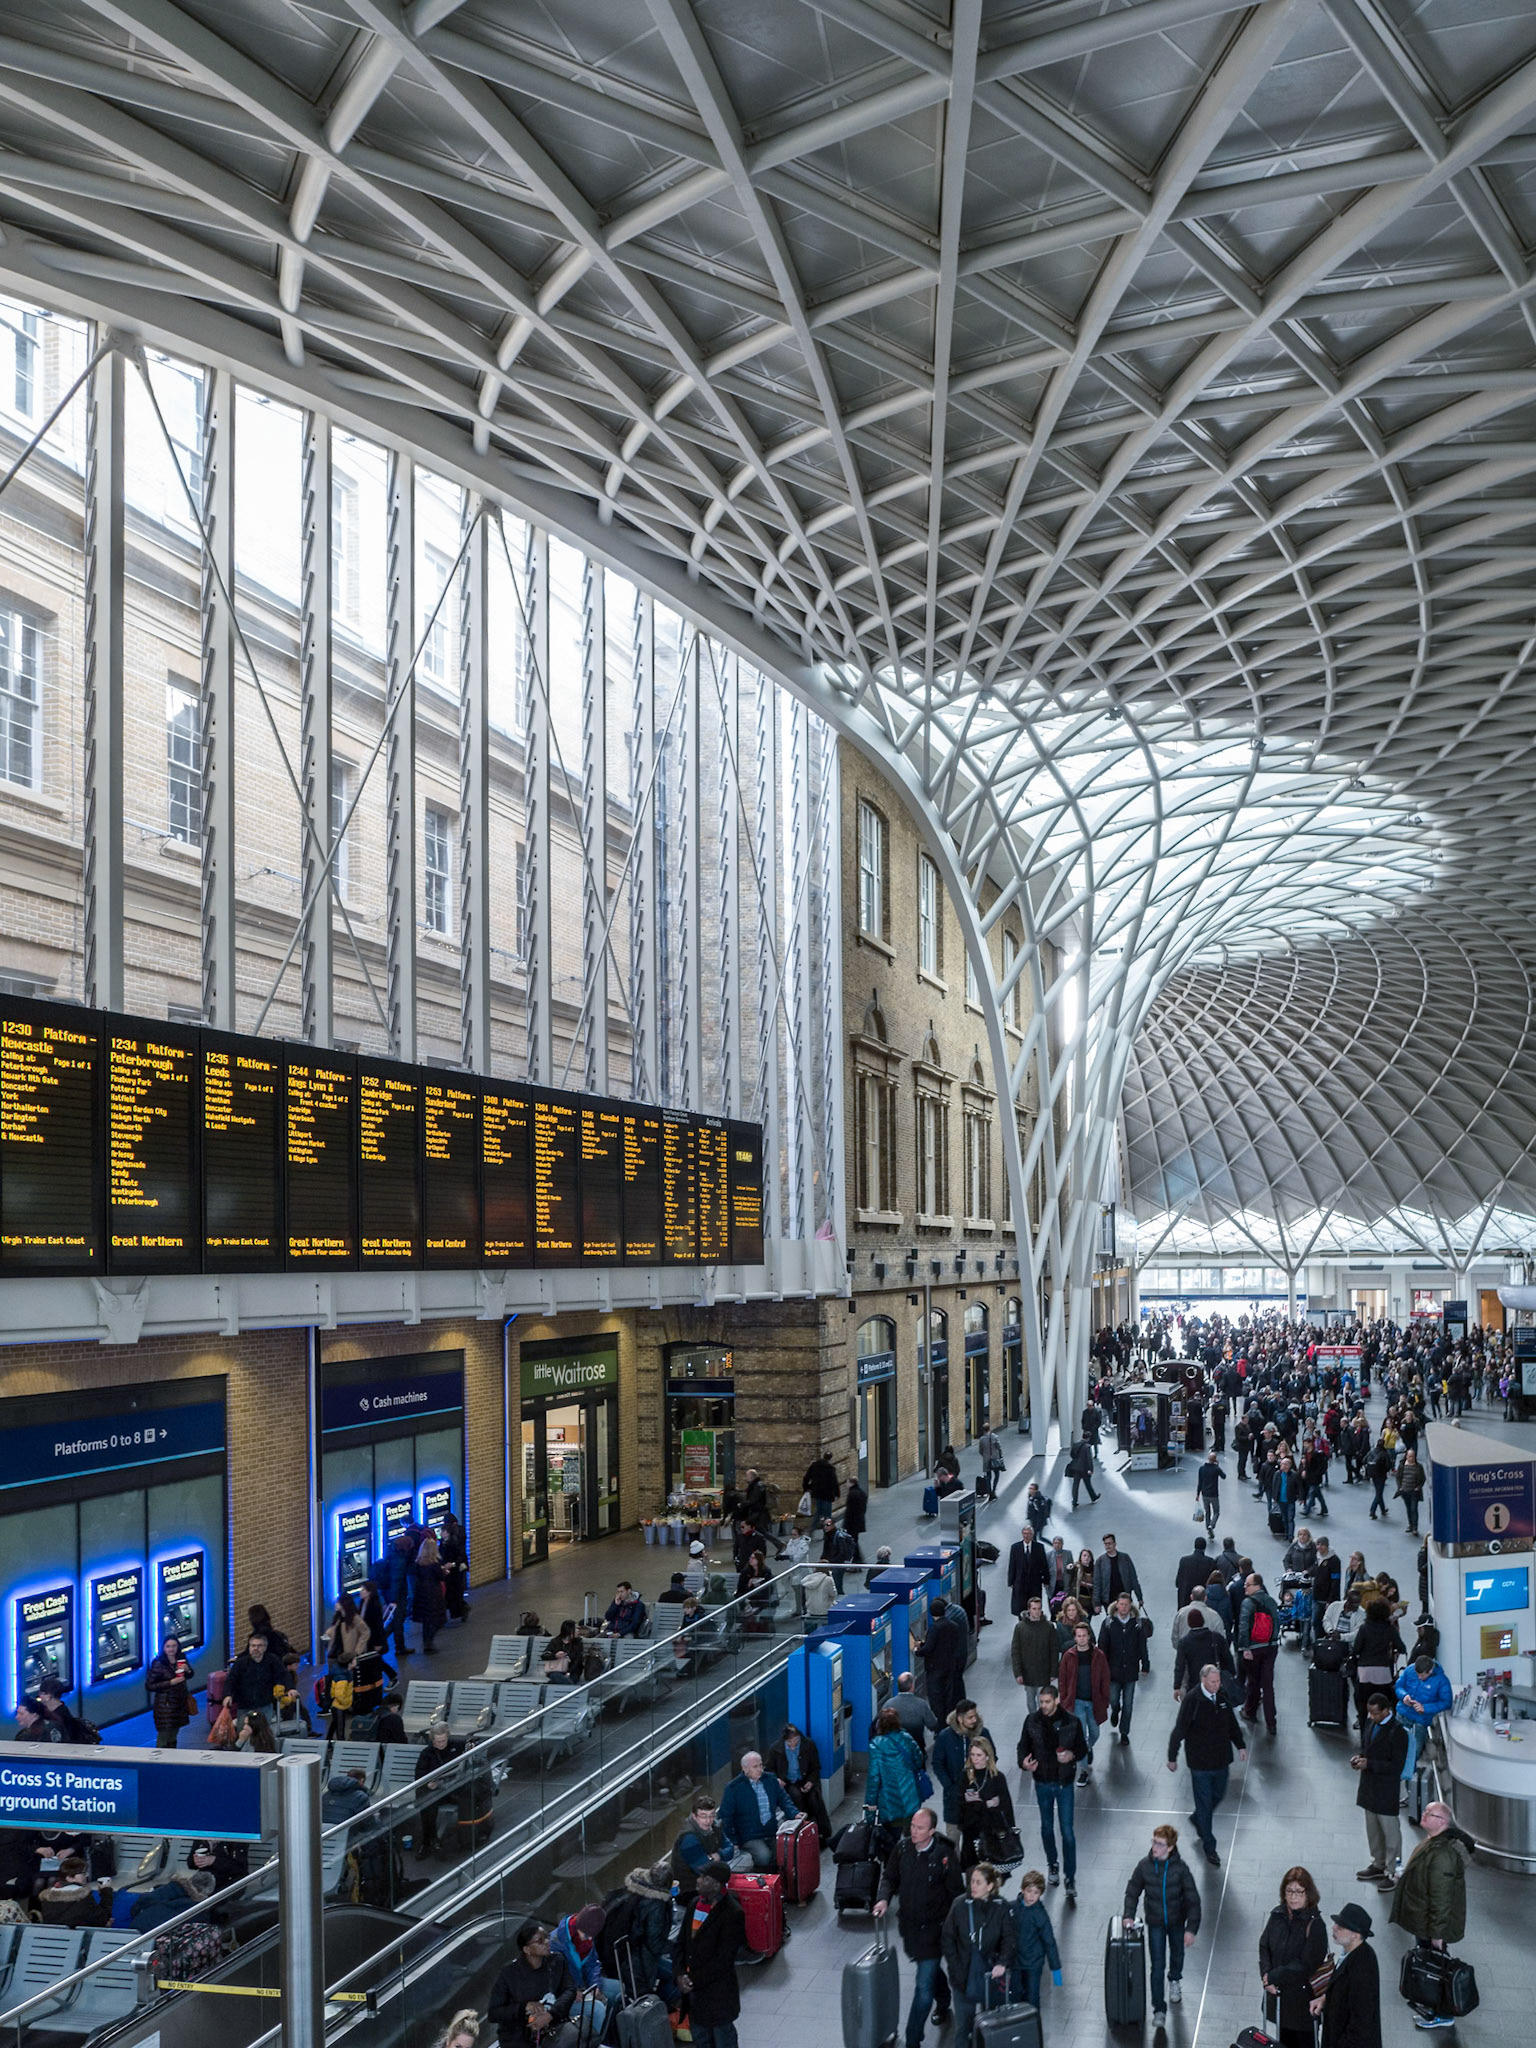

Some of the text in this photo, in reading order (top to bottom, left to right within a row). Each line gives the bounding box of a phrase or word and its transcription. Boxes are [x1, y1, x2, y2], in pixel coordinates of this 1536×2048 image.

[2, 1021, 87, 1044] 12:30 Platform
[1, 1036, 54, 1054] Newcastle
[112, 1037, 185, 1059] 12:34 Platform
[1, 1051, 37, 1062] Calling at:
[54, 1057, 70, 1068] Page
[111, 1051, 174, 1071] Peterborough
[206, 1052, 270, 1071] 12:35 Platform
[1, 1061, 48, 1075] Peterborough
[111, 1065, 142, 1076] Calling at:
[205, 1065, 230, 1078] Leeds
[1, 1071, 27, 1082] Newark
[42, 1076, 59, 1085] Gate
[111, 1074, 152, 1087] Finsbury Park
[156, 1071, 170, 1081] Page
[176, 1074, 183, 1082] of
[316, 1068, 346, 1083] Platform
[1, 1081, 37, 1093] Doncaster
[205, 1077, 223, 1088] Calling
[245, 1082, 257, 1092] Page
[288, 1076, 308, 1089] Kings
[309, 1079, 327, 1092] Lynn
[1, 1091, 19, 1101] York
[111, 1084, 148, 1096] Potters Bar
[361, 1087, 393, 1101] Cambridge
[111, 1093, 136, 1103] Hatfield
[1, 1101, 49, 1114] Northallerton
[133, 1105, 154, 1115] Garden
[155, 1107, 168, 1117] City
[205, 1103, 233, 1113] Doncaster
[1, 1112, 37, 1123] Darlington
[133, 1115, 151, 1124] North
[1, 1122, 27, 1132] Durham
[211, 1121, 228, 1131] Leeds
[1, 1132, 44, 1143] & Newcastle
[111, 1131, 143, 1142] Stevenage
[111, 1150, 135, 1160] Arlesey
[111, 1168, 130, 1179] Sandy
[118, 1197, 159, 1207] Peterborough
[2, 1235, 85, 1246] Virgin Trains East Coast
[112, 1235, 183, 1247] Great Northern
[206, 1238, 269, 1246] Virgin Trains East Coast
[289, 1237, 345, 1248] Great Northern
[362, 1238, 411, 1248] Great Northern
[534, 1360, 606, 1387] little Waitrose
[373, 1391, 428, 1408] Cash machines
[55, 1432, 141, 1457] Platforms 0 to 8
[1469, 1469, 1524, 1483] King's Cross
[342, 1512, 369, 1527] Free Cash
[163, 1559, 199, 1577] Free Cash
[97, 1575, 138, 1595] Free Cash
[23, 1594, 69, 1615] Free Cash
[1, 1768, 123, 1791] Cross St Pancras
[61, 1794, 116, 1813] Station
